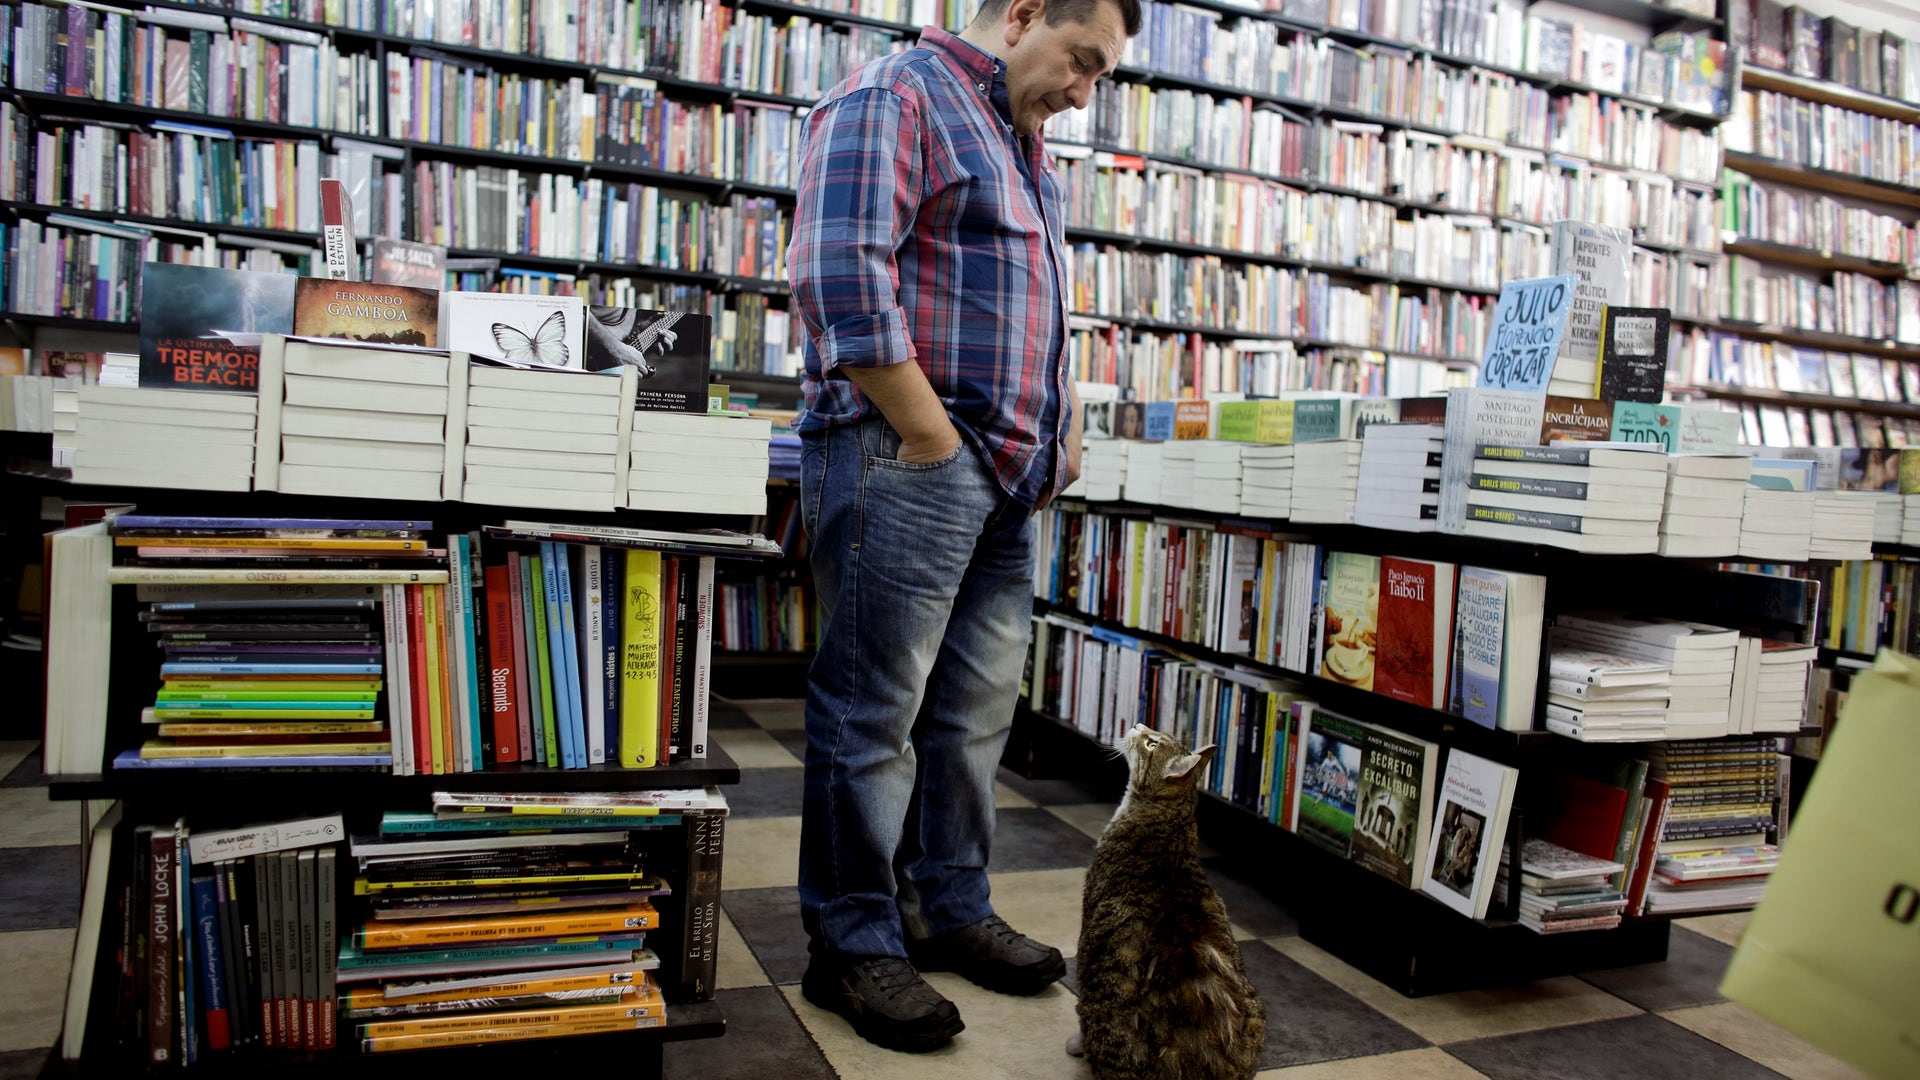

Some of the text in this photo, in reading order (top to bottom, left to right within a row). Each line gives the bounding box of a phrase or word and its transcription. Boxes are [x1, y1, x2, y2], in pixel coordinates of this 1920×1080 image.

[336, 227, 345, 266] ESTULIN
[1576, 239, 1611, 257] APUNTES
[1576, 254, 1596, 269] PARA
[334, 290, 404, 307] FERNANDO
[1504, 283, 1565, 326] JULIO
[1573, 299, 1608, 313] EXTERIO
[327, 301, 409, 322] GAMBOA
[1572, 312, 1591, 326] POST
[158, 338, 172, 346] LA
[177, 339, 215, 351] ÚLTIMA
[1618, 341, 1644, 350] DIARIO
[156, 347, 260, 370] TREMOR
[173, 365, 257, 387] BEACH
[1484, 401, 1532, 414] SANTIAGO
[1573, 404, 1585, 416] LA
[1476, 414, 1536, 428] POSTEGUILLO
[1545, 412, 1610, 429] ENCRUCIJADA
[1481, 426, 1528, 439] LA SANGRE
[1484, 447, 1524, 458] CÓDIGO STIUSO
[1480, 478, 1520, 493] CÓDIGO STIUSO
[1474, 508, 1516, 523] CÓDIGO STIUSO
[246, 572, 288, 582] FAUSTO
[548, 570, 556, 594] MUNDIAL
[1388, 568, 1426, 585] Paco Ignacio
[1388, 580, 1424, 602] Taibo II
[1464, 590, 1500, 609] TE LLEVARÉ
[590, 559, 601, 642] JUDÍOS LANGER
[697, 594, 706, 630] SNOWDEN
[1468, 605, 1476, 616] UN
[1476, 607, 1500, 624] LUGAR
[678, 628, 684, 636] EL
[1474, 622, 1498, 638] DONDE
[628, 644, 658, 652] MAITENA
[676, 637, 684, 663] LIBRO
[1468, 632, 1497, 652] TODO ES
[628, 652, 658, 660] MUJERES
[1468, 646, 1496, 666] POSIBLE
[606, 652, 616, 678] chistes
[626, 660, 658, 670] ALTERADAS
[492, 668, 513, 713] Seconds
[608, 678, 616, 700] mejores
[698, 664, 706, 701] GREENWALD
[608, 700, 616, 710] Los
[671, 678, 682, 734] CEMENTERIO
[1367, 735, 1420, 759] ANDY McDERMOTT
[1370, 750, 1414, 778] SECRETO
[1364, 768, 1416, 800] EXCALIBUR
[154, 853, 170, 944] JOHN LOCKE
[470, 928, 497, 936] PANTERA
[693, 906, 703, 941] BRILLO
[489, 1018, 518, 1026] INVISIBLE
[519, 1016, 550, 1024] MONSTRUO
